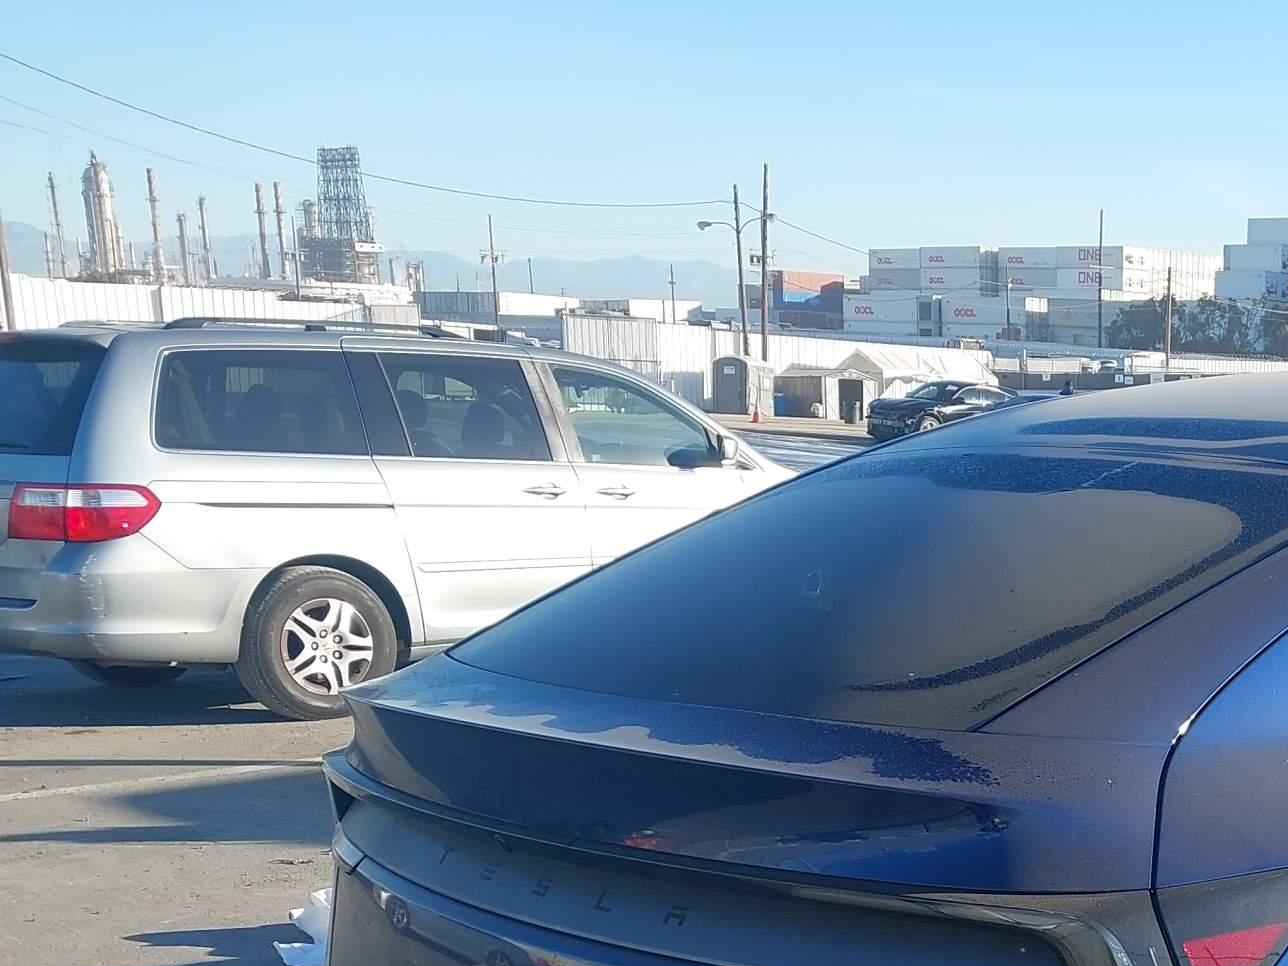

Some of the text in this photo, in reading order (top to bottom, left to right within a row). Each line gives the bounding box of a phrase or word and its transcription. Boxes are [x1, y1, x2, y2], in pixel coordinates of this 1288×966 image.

[855, 306, 874, 315] OOCL
[954, 308, 976, 317] OOCL
[438, 846, 691, 928] TESLA
